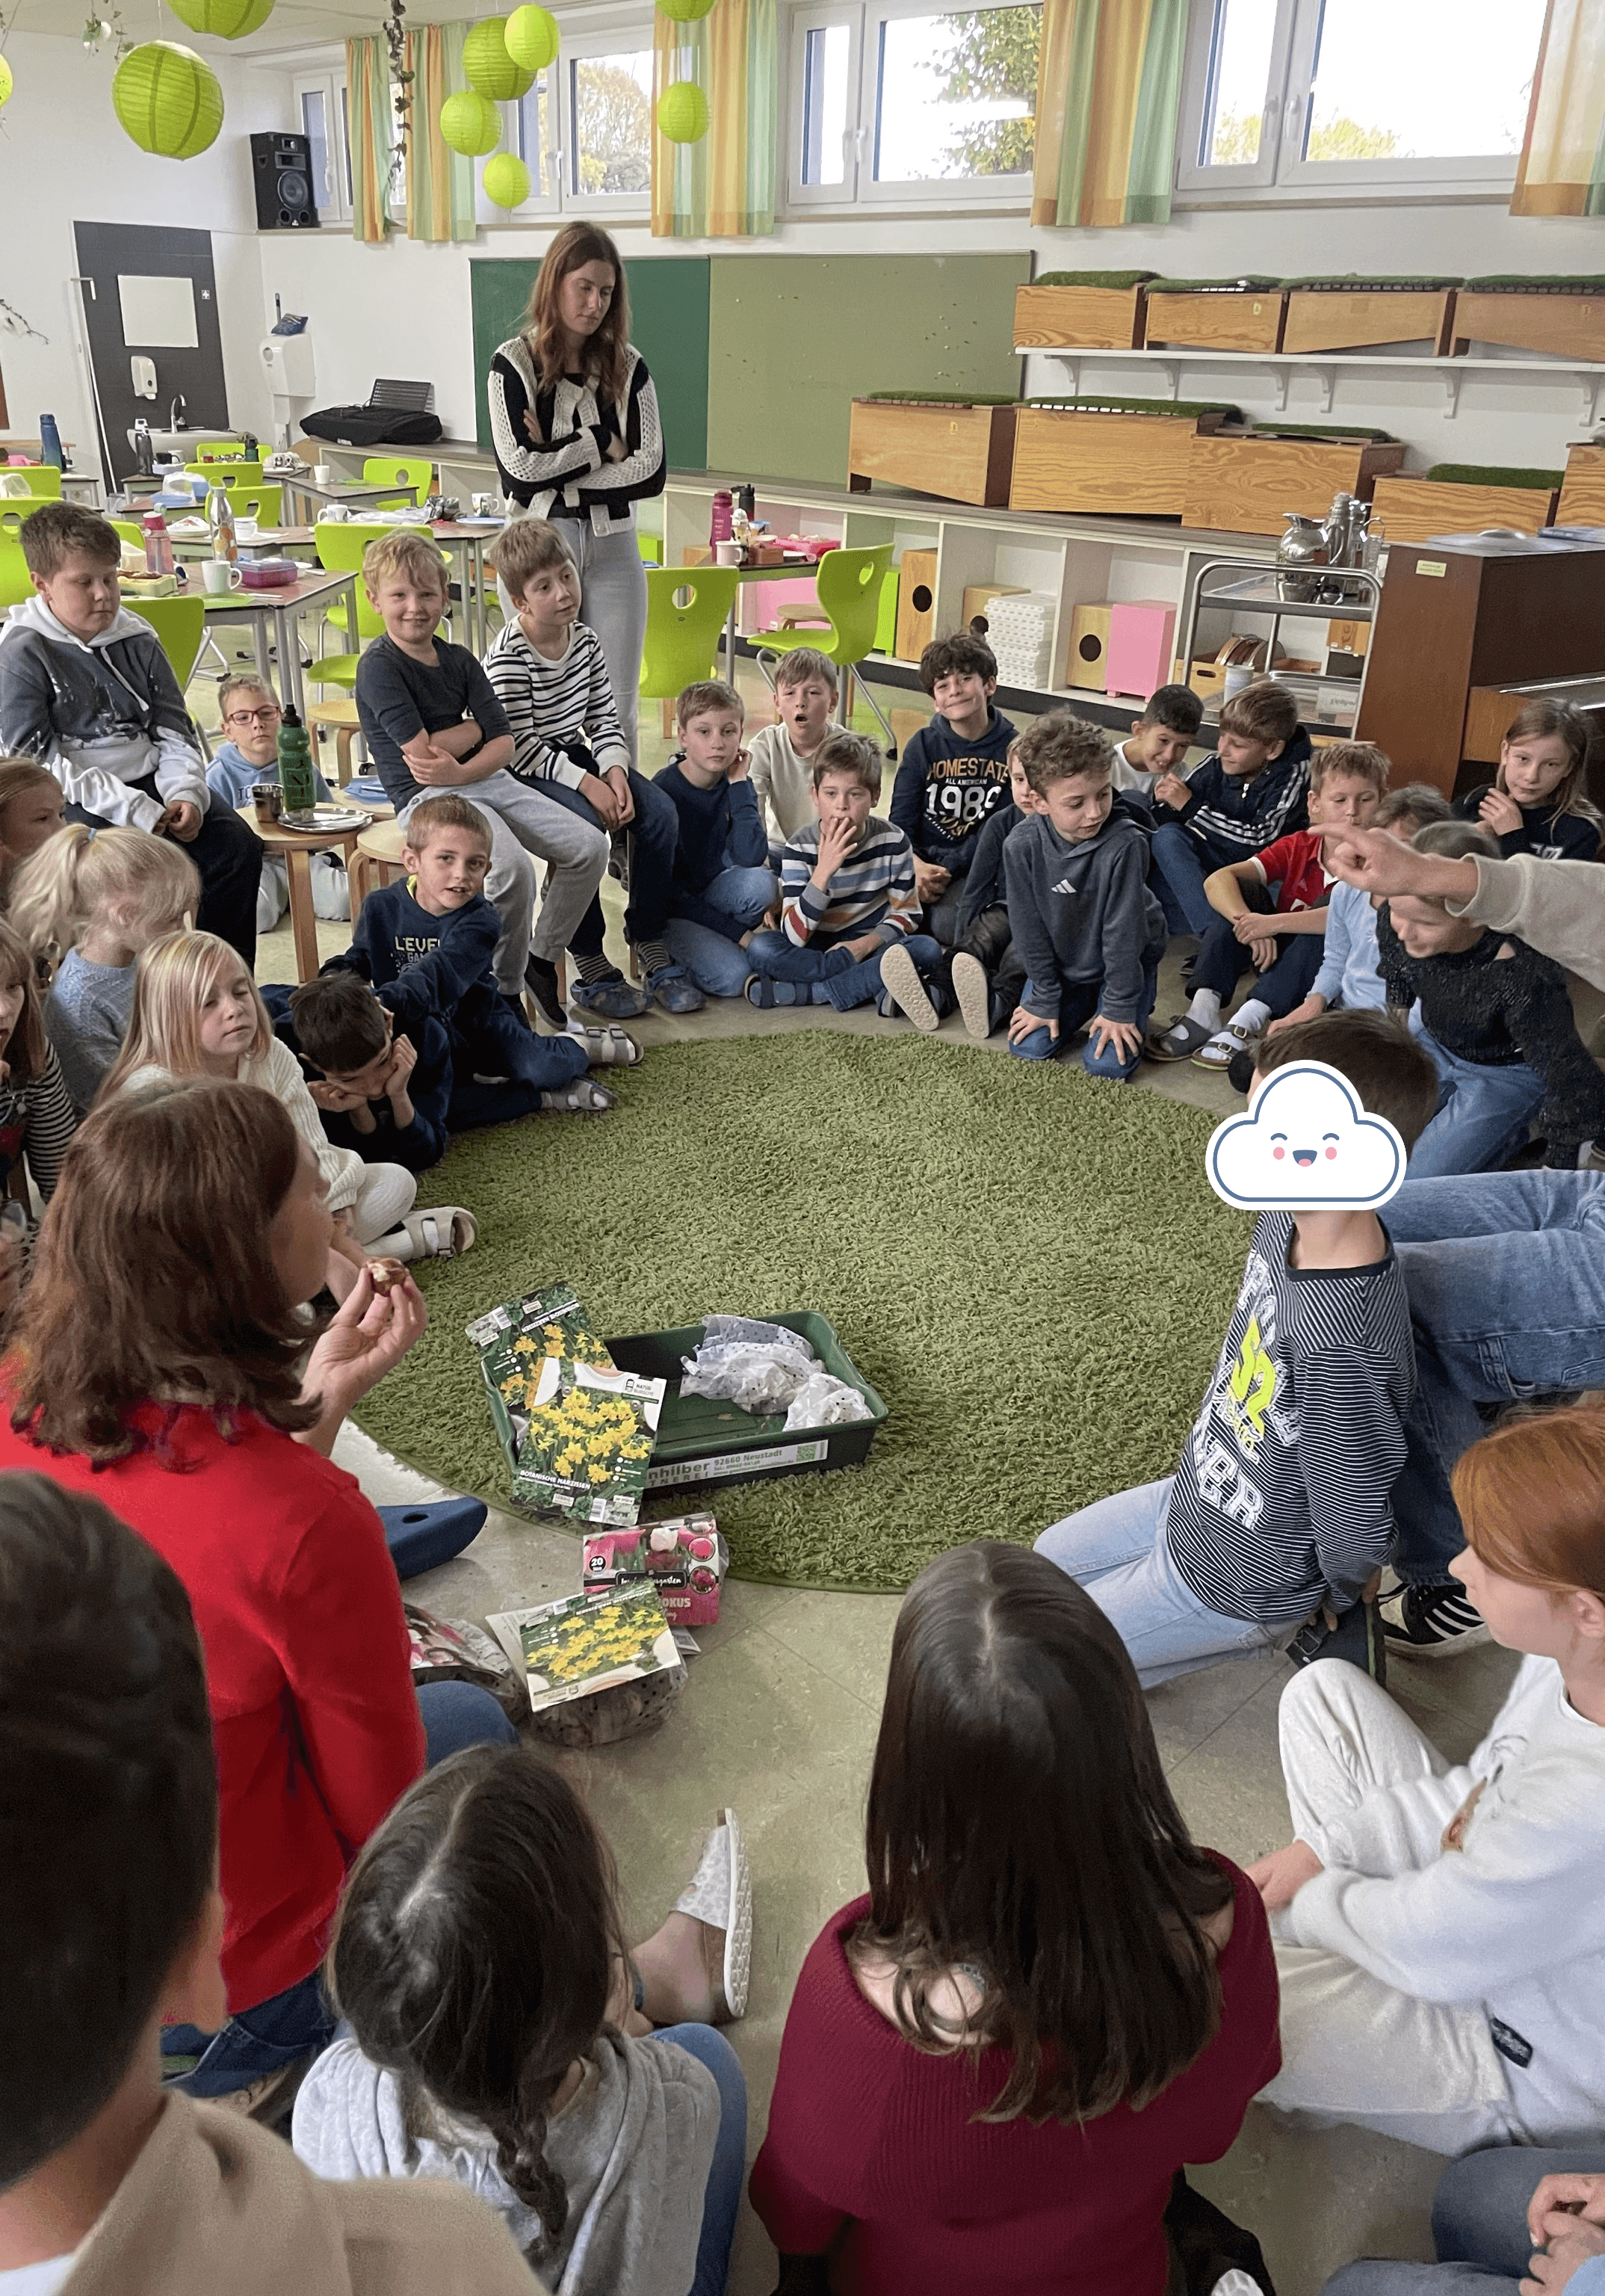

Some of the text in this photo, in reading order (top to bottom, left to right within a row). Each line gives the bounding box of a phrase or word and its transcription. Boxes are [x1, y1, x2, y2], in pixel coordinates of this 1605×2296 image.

[743, 1449, 783, 1462] Neustadt
[648, 1462, 710, 1481] nhilber
[519, 1469, 557, 1484] BOTANISCHE
[557, 1477, 592, 1490] NARZISSEN
[591, 1557, 604, 1567] 20
[661, 1597, 691, 1608] OKUS
